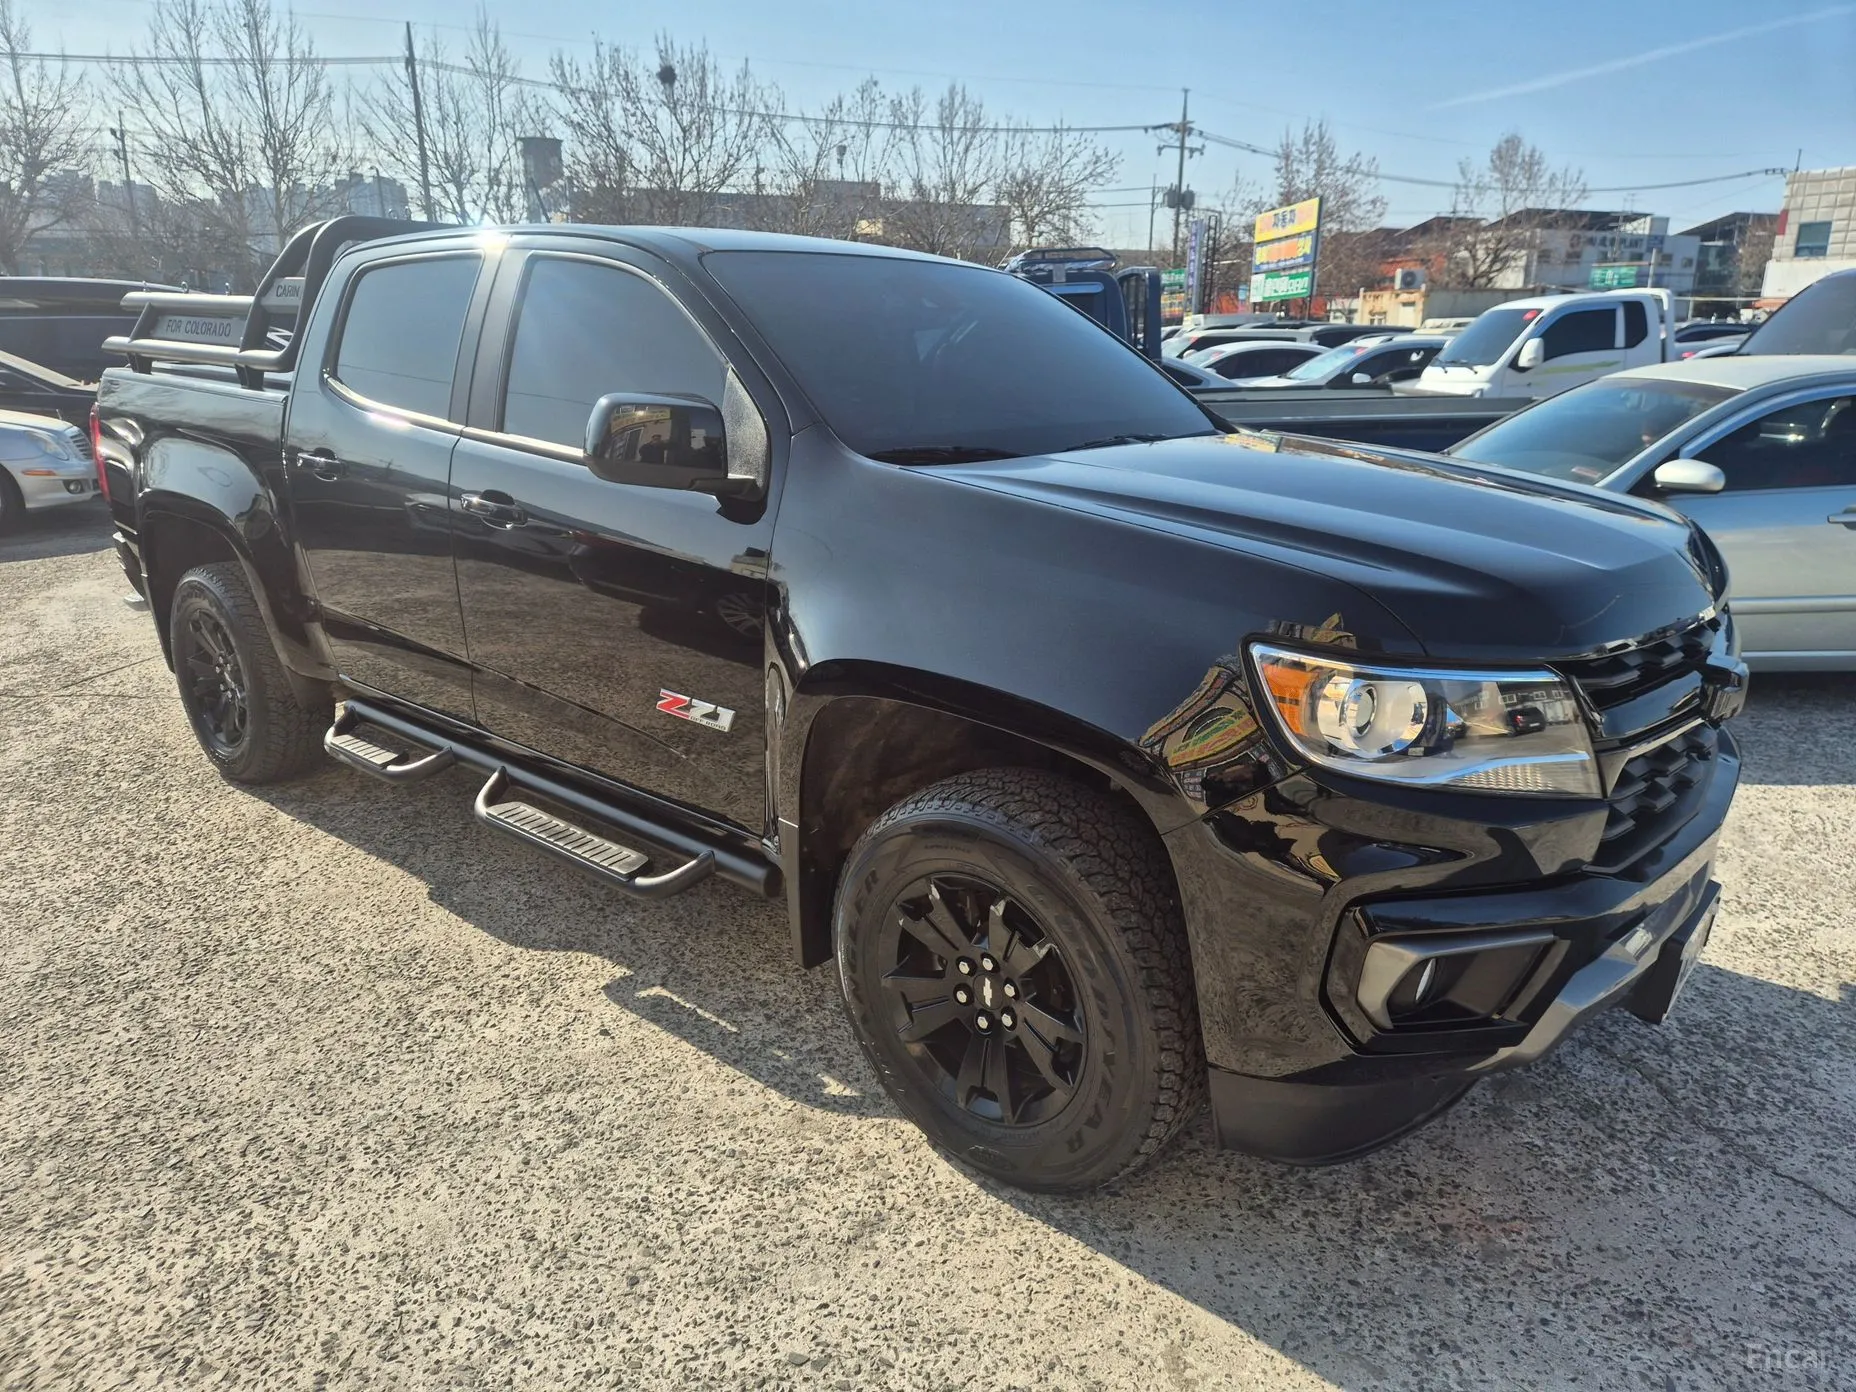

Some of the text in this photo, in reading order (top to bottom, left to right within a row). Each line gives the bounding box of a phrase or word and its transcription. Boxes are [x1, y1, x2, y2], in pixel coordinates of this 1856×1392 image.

[166, 319, 232, 337] FOR COLORADO
[656, 688, 736, 732] Z71
